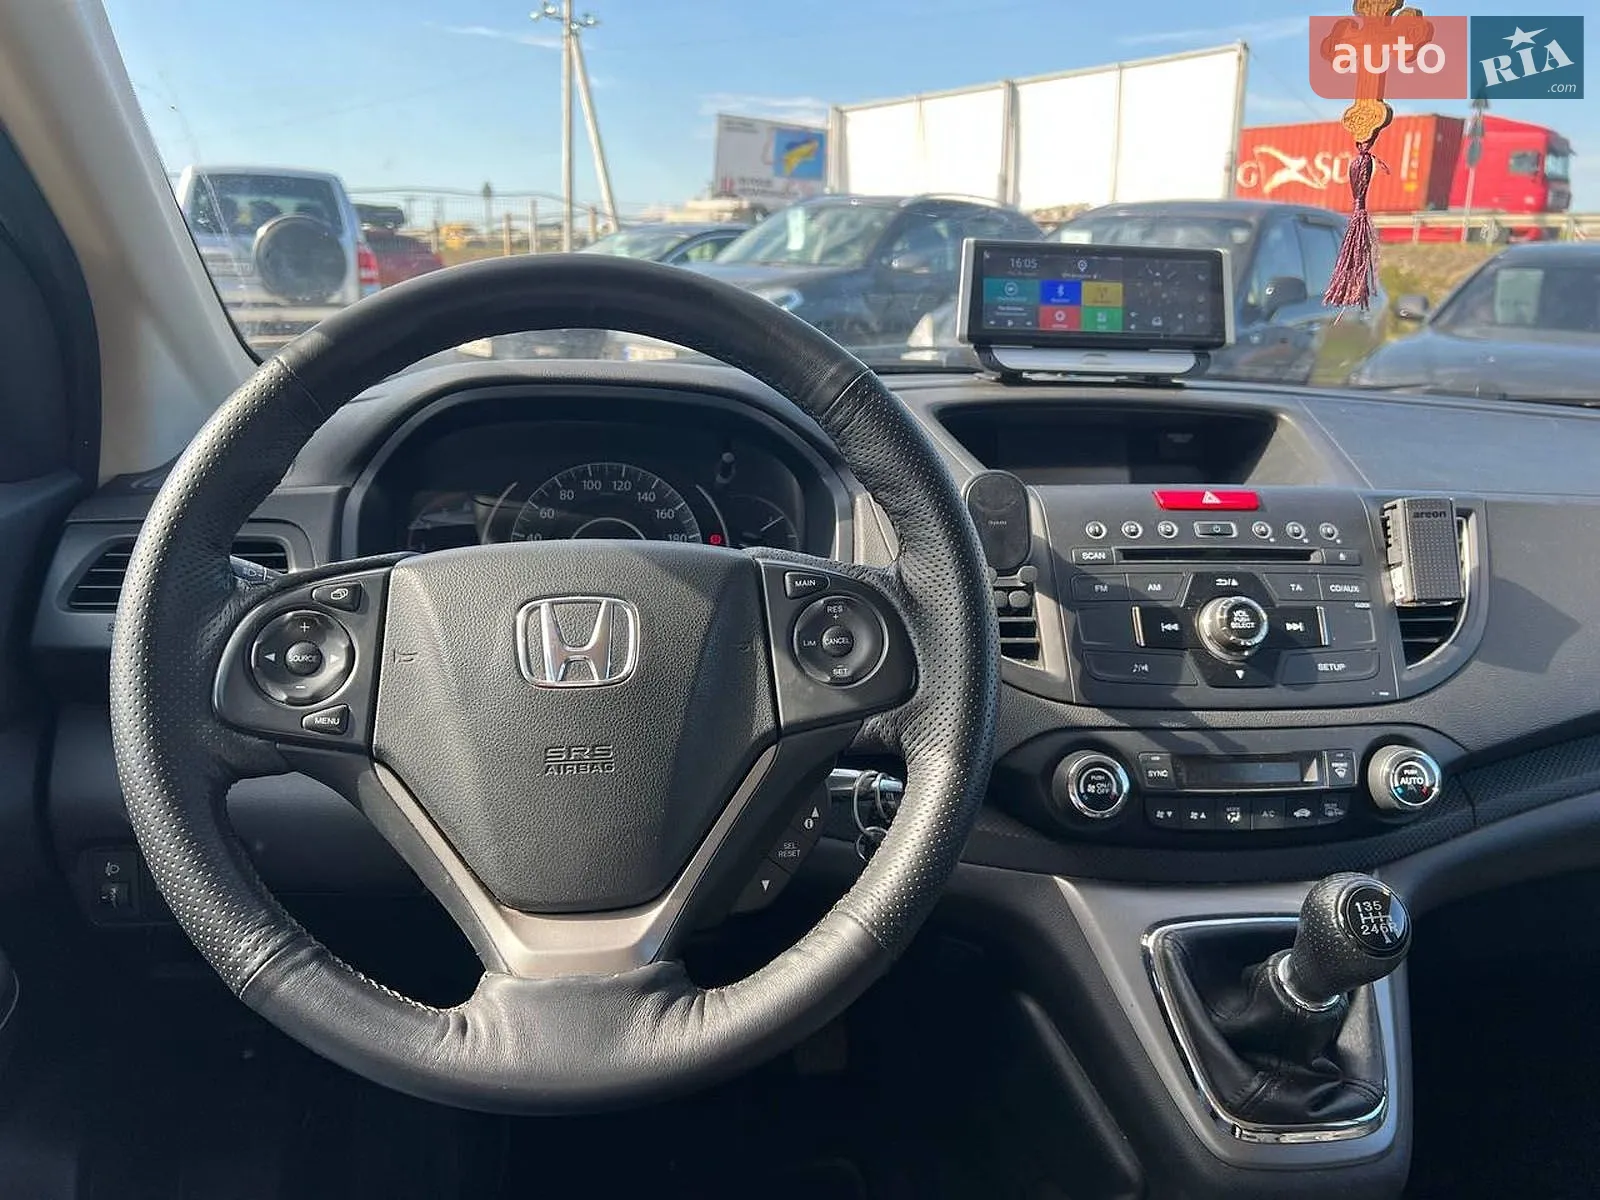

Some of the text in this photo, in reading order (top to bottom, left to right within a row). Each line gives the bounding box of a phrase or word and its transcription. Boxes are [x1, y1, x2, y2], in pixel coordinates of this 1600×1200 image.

[1010, 258, 1037, 269] 16:05
[582, 480, 601, 490] 100
[612, 480, 632, 491] 120
[559, 490, 575, 500] 80
[637, 491, 656, 502] 140
[539, 508, 555, 519] 60
[655, 508, 675, 519] 160
[1082, 552, 1106, 560] SCAN
[1094, 584, 1108, 593] FM
[1147, 583, 1162, 592] AM
[1290, 583, 1303, 592] TA
[827, 605, 843, 613] RES
[289, 654, 318, 662] SOURCE
[1317, 663, 1346, 671] SETUP
[314, 717, 340, 725] MENU
[545, 746, 613, 761] SRS
[545, 763, 615, 776] AIRBAG
[1400, 777, 1424, 785] AUTO
[778, 849, 801, 857] RESET
